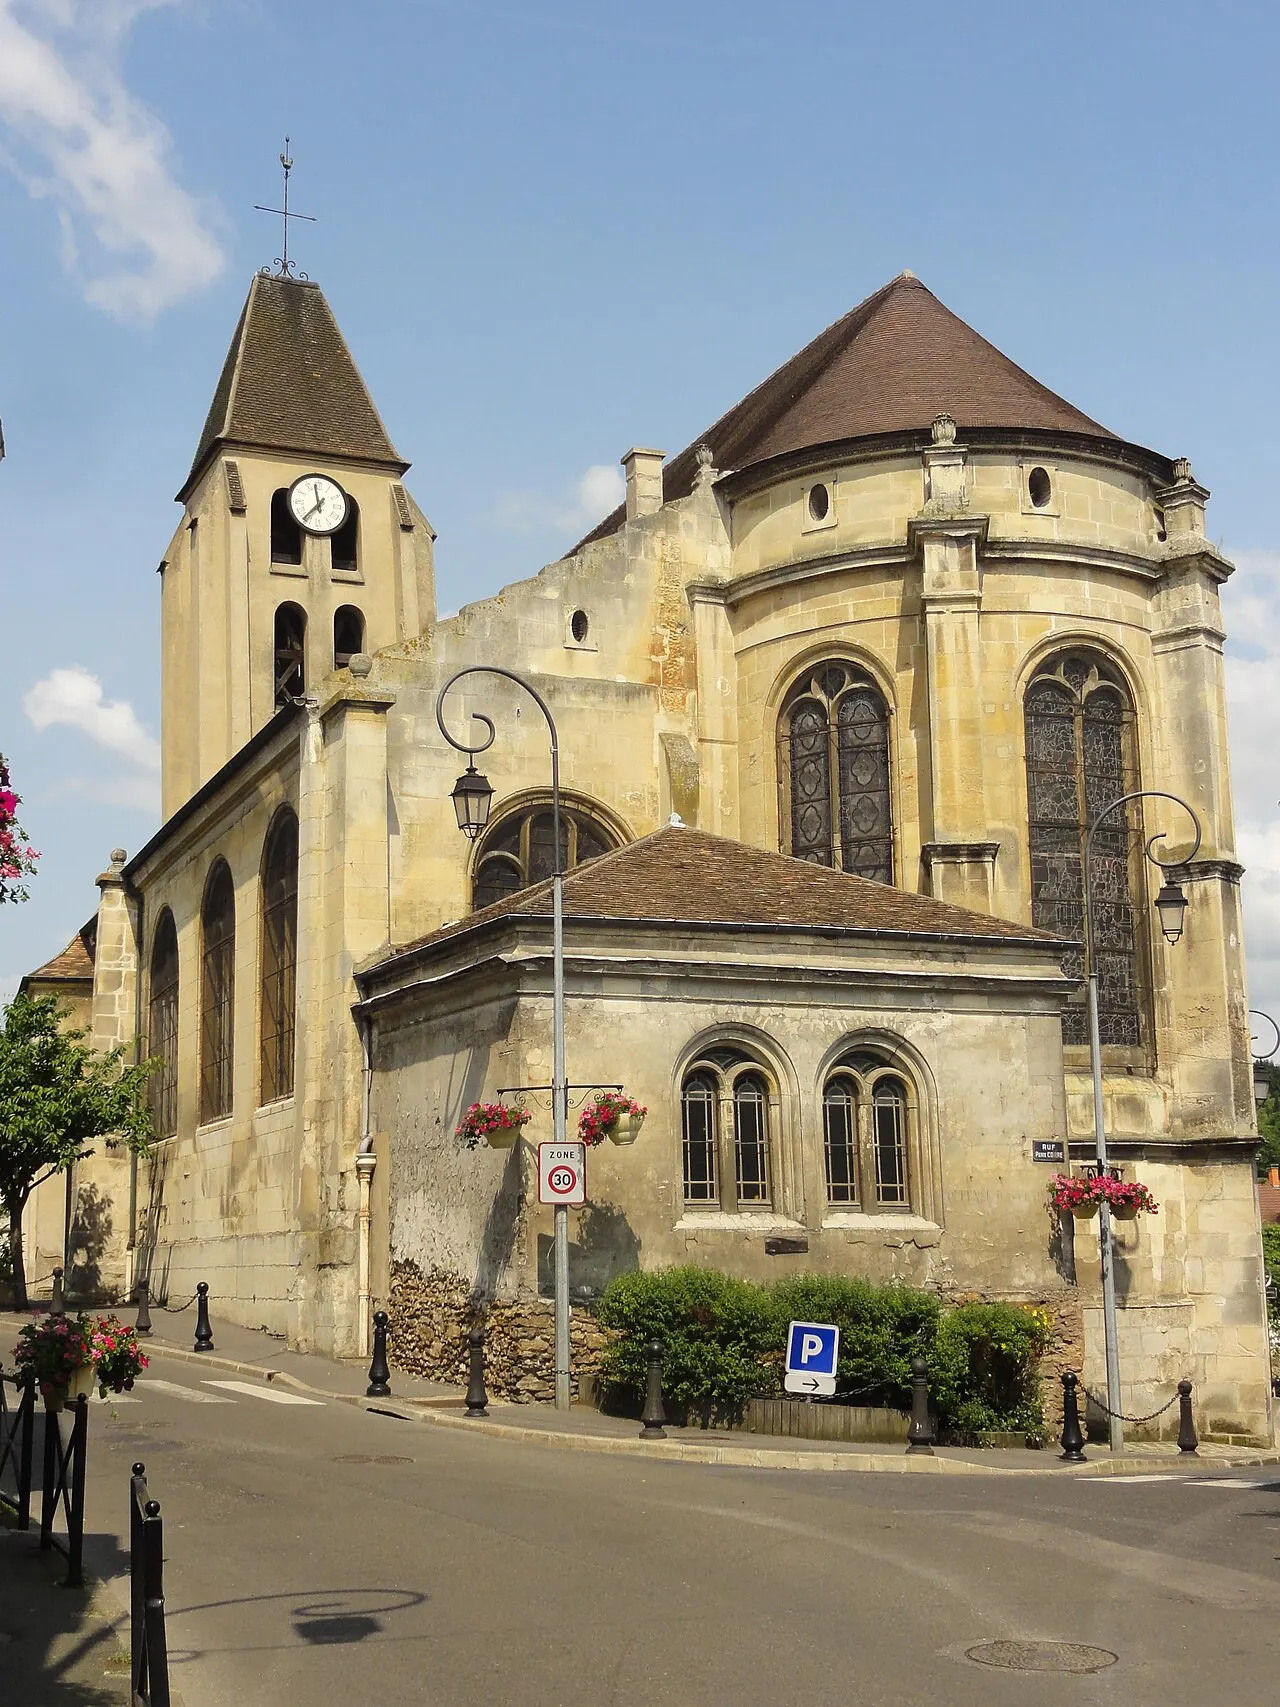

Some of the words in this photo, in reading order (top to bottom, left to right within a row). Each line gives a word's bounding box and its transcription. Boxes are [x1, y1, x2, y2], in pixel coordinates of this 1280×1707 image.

[550, 1151, 575, 1159] ZONE
[554, 1174, 571, 1186] 30
[801, 1333, 823, 1364] P
